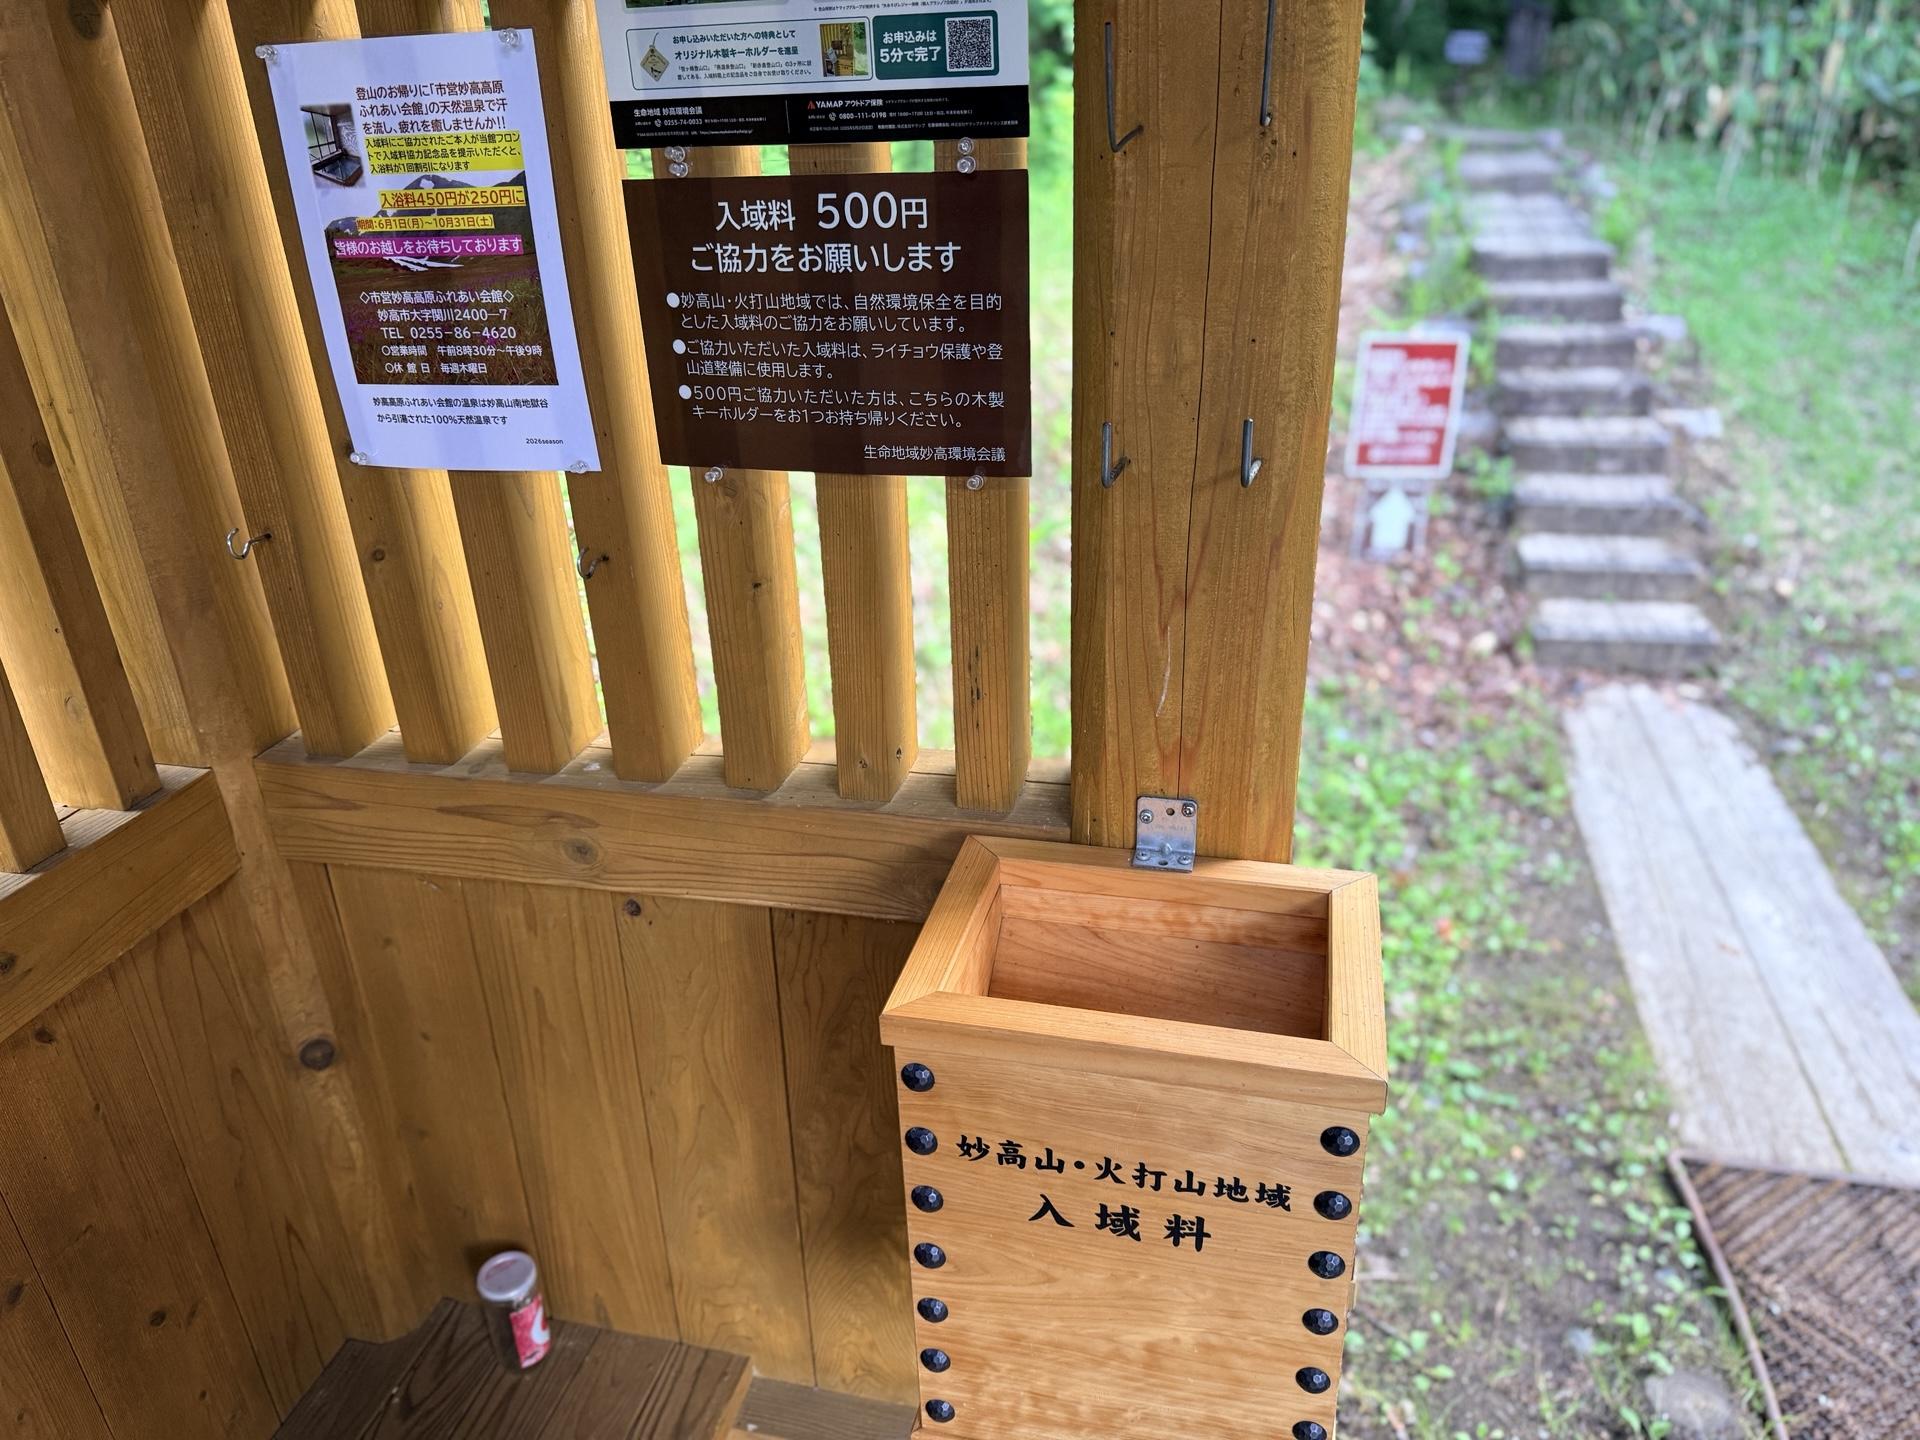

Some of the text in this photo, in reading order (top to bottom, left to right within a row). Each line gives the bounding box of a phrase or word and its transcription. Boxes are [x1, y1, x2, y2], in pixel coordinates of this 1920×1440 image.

[882, 29, 937, 44] お申込みは
[880, 46, 941, 63] 5分で完了
[356, 80, 504, 101] 登山のお帰りに「市営妙高高原
[359, 98, 508, 117] ふれあい会館」の天然温泉で汗
[816, 100, 843, 108] YAMAP
[844, 98, 883, 107] アウトドア保険
[366, 132, 520, 148] 入域料にご協力されたご本人が当館フロン
[368, 145, 521, 161] トで入域料協力記念品を提示いただくと、
[371, 160, 470, 174] 入浴料が1回割引になります
[381, 189, 525, 207] 入浴料450円が250円に
[715, 191, 928, 231] 入域料 500円
[334, 237, 522, 256] 皆様のお越しをお待ちしております
[690, 242, 963, 274] ご協力をお願いします
[681, 313, 967, 333] とした入域料のご協力をお願いしています。
[380, 326, 517, 339] TEL 0255-86-4620
[686, 339, 1004, 361] ご協力いただいた入域料は、ライチョウ保護や登
[440, 363, 488, 375] 毎週木曜日
[686, 360, 835, 380] 山道整備に使用します。
[372, 397, 549, 409] 妙高高原ふれあい会館の温泉は妙高山南地獄谷
[693, 385, 1005, 408] 500円ご協力いただいた方は、こちらの木製
[377, 414, 508, 425] から引湯された100%天然温泉です
[692, 405, 964, 429] キーホルダーをお1つお持ち帰りください。
[863, 444, 1006, 462] 生命地域妙高環境会議
[955, 1134, 1292, 1213] 妙高山・火打山地域
[1028, 1193, 1212, 1252] 入域料
